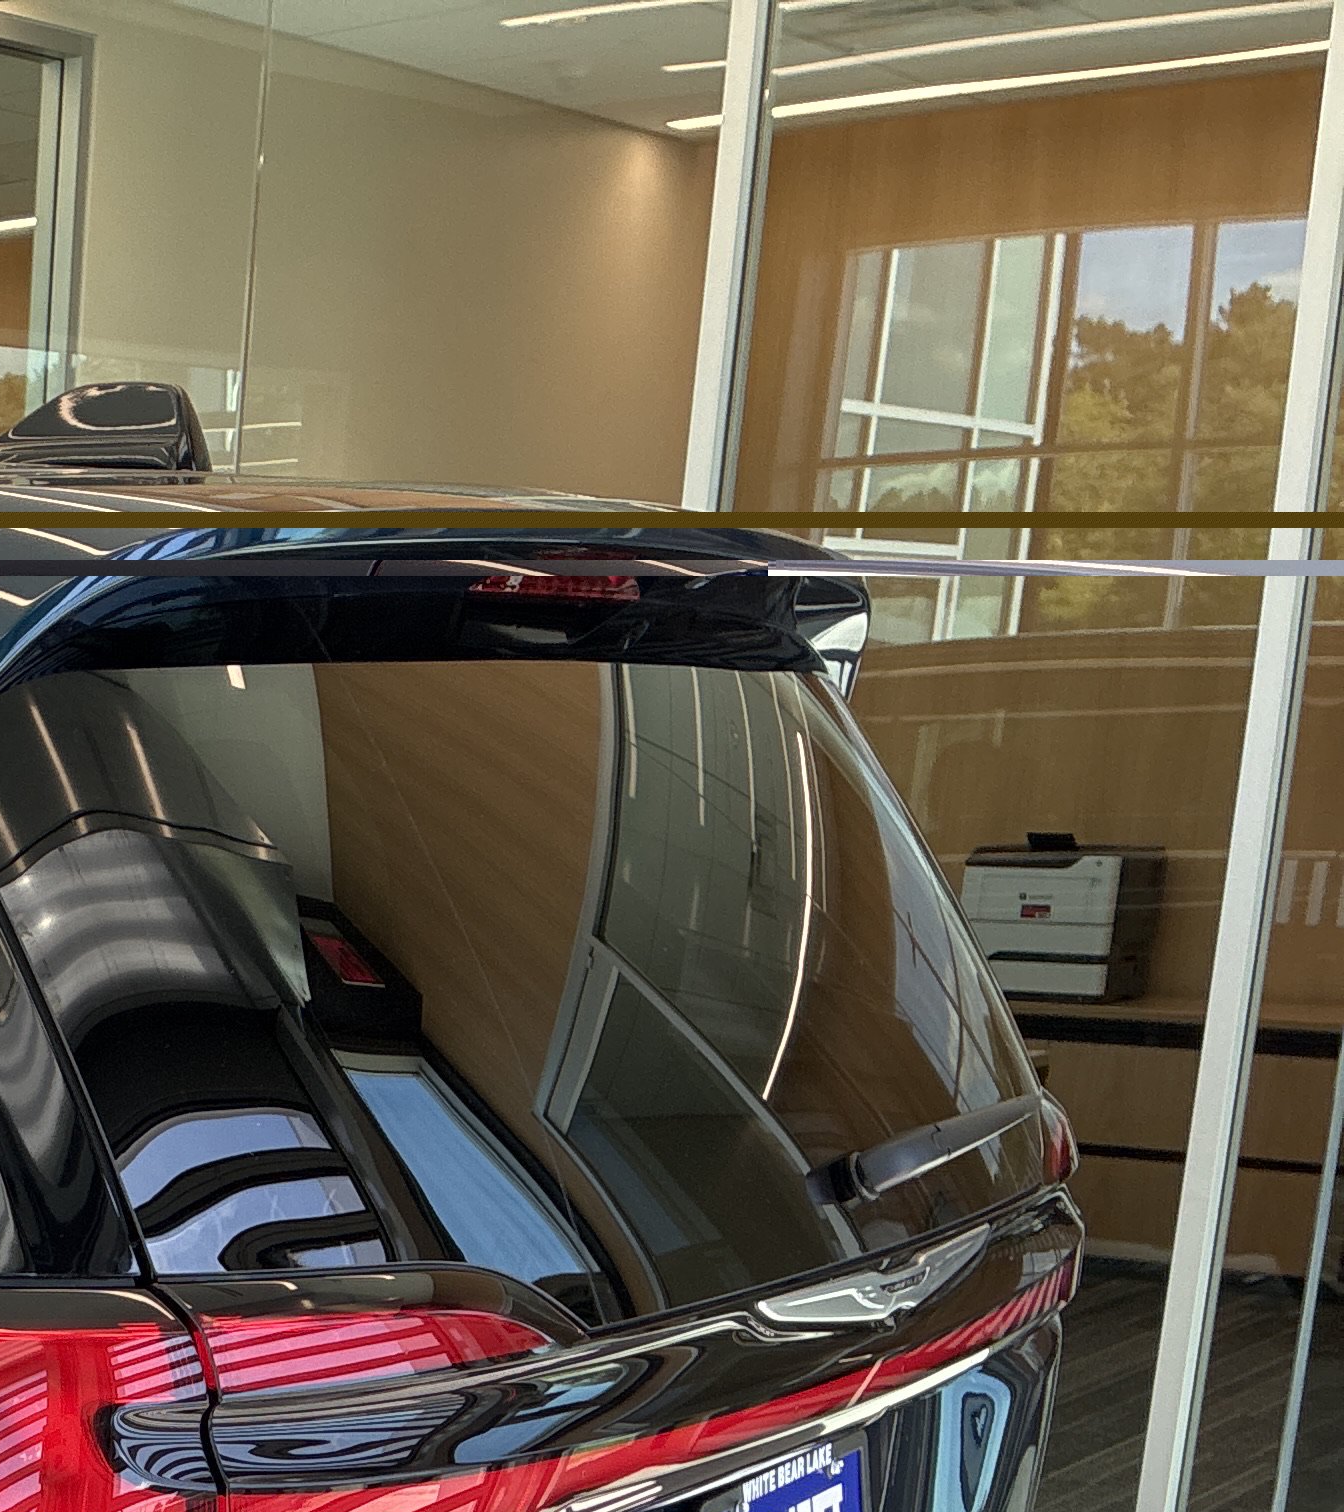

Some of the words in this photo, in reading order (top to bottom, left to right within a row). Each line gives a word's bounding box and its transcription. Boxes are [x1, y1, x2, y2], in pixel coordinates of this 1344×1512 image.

[742, 1468, 777, 1503] WHITE
[777, 1456, 805, 1488] BEAR
[806, 1442, 833, 1475] LAKE
